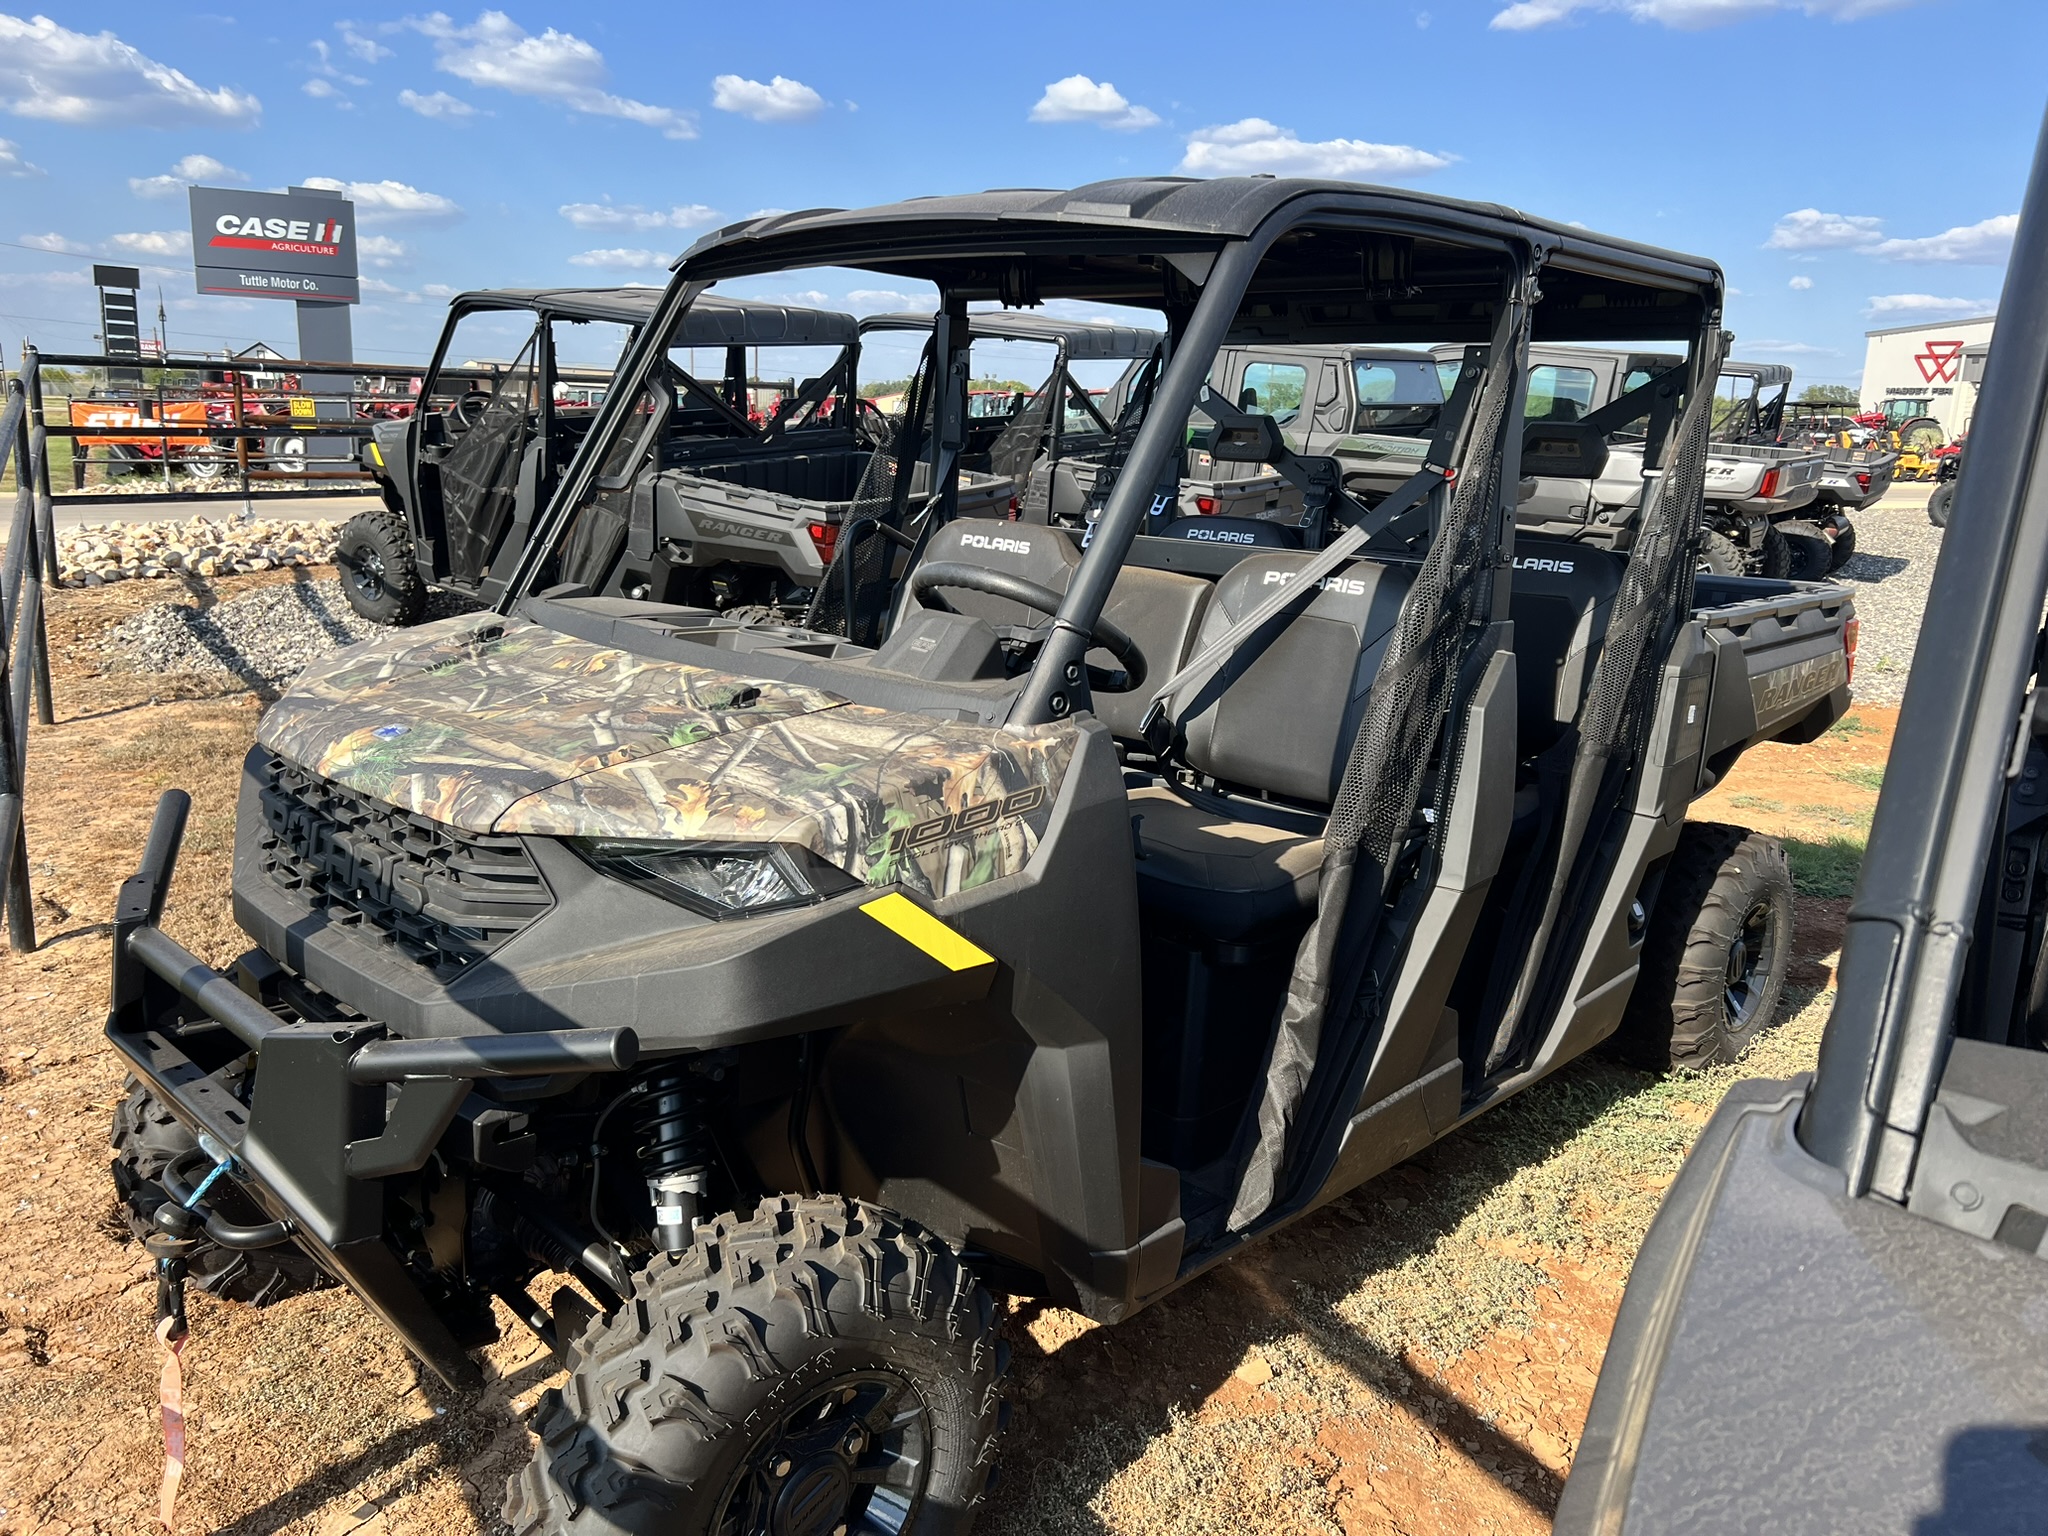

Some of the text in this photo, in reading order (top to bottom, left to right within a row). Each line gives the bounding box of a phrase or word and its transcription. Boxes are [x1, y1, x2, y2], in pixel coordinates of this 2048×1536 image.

[216, 214, 310, 241] CASE
[271, 242, 335, 255] AGRICULTURE
[239, 274, 319, 291] Tuttle Motor Co.
[1363, 442, 1420, 454] XPEDITION
[1255, 510, 1281, 520] POLARIS
[698, 519, 783, 542] RANGER
[1186, 528, 1255, 544] POLARIS
[960, 533, 1031, 555] POLARIS
[1512, 556, 1574, 574] LARIS
[1263, 570, 1366, 595] PARIS
[1757, 660, 1842, 714] RANGER
[890, 784, 1047, 855] 1000
[259, 783, 430, 915] POLARIS
